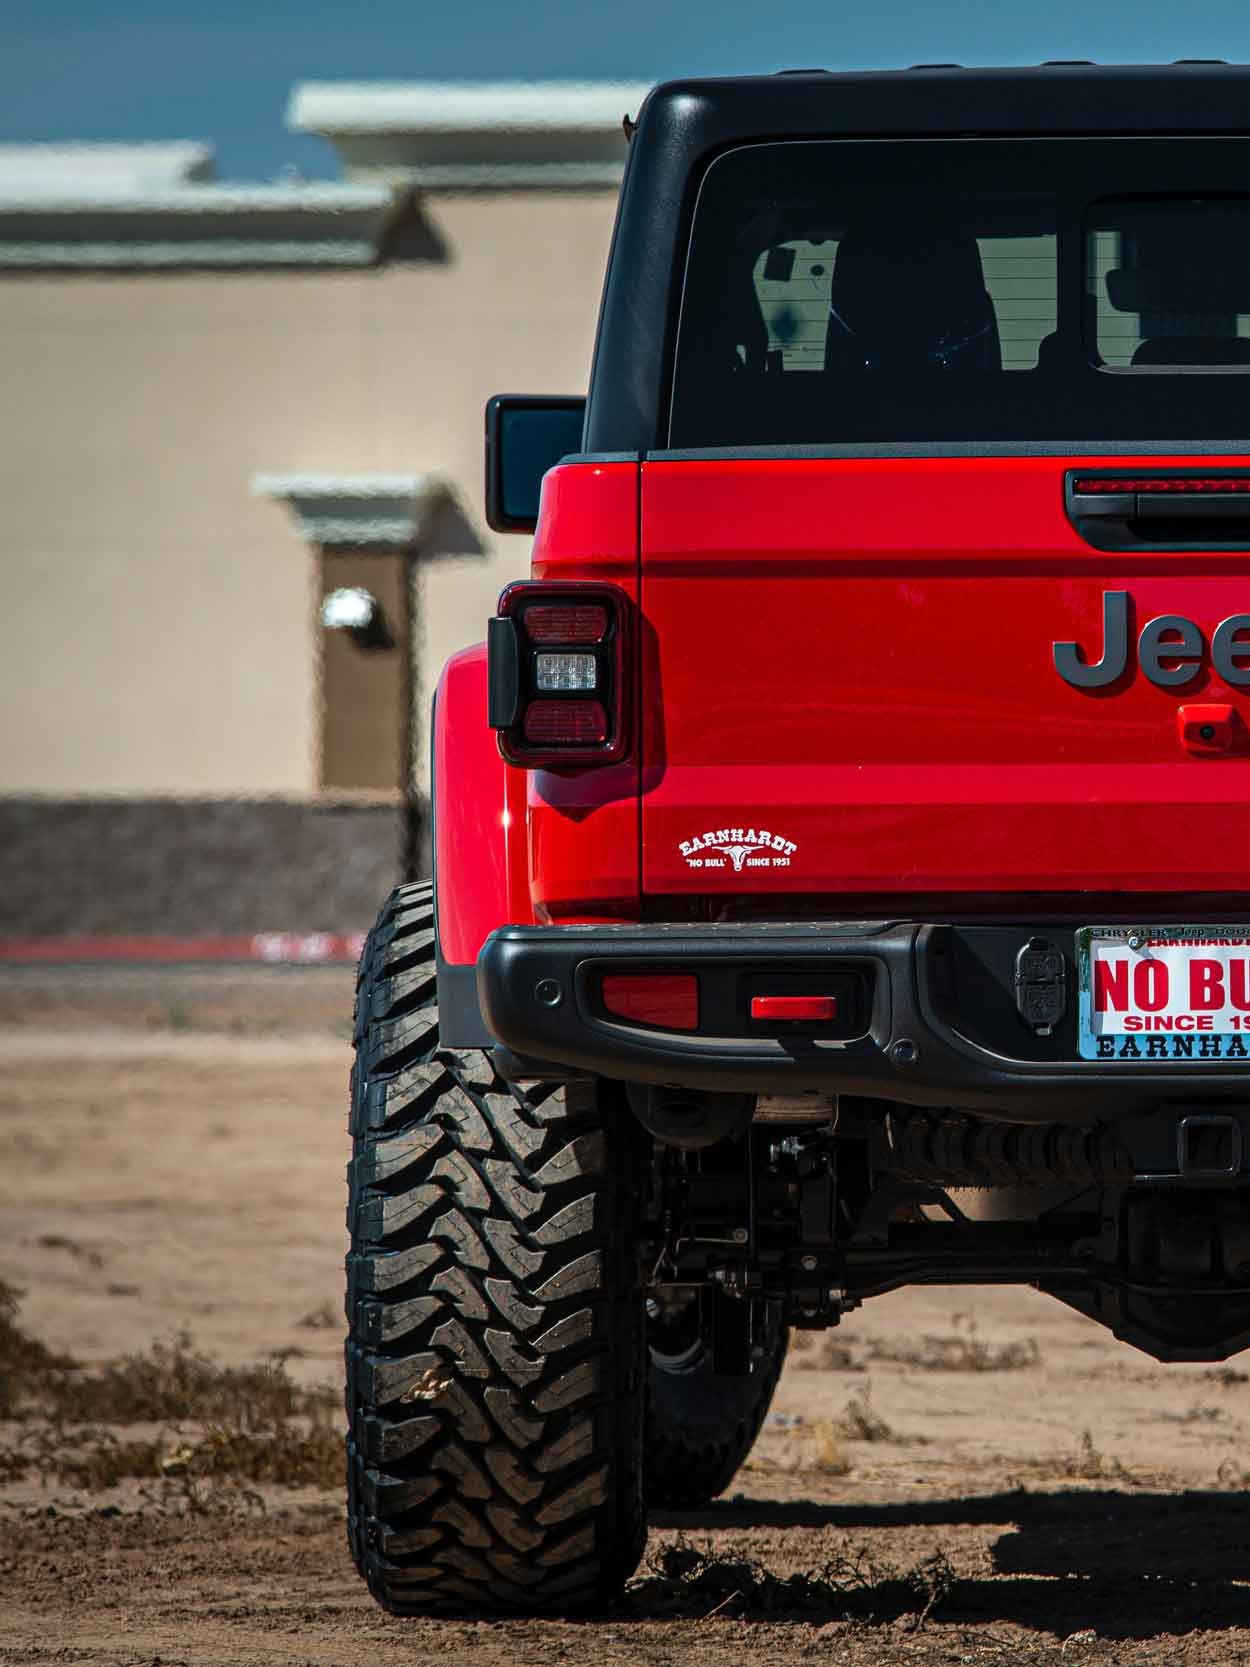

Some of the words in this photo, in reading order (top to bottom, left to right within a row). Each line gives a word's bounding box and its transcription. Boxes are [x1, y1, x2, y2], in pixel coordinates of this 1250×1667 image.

[679, 829, 797, 856] EARNHARDT
[746, 858, 770, 867] SINCE
[772, 858, 790, 867] 1951
[1095, 959, 1169, 1012] NO
[1124, 1015, 1214, 1031] SINCE
